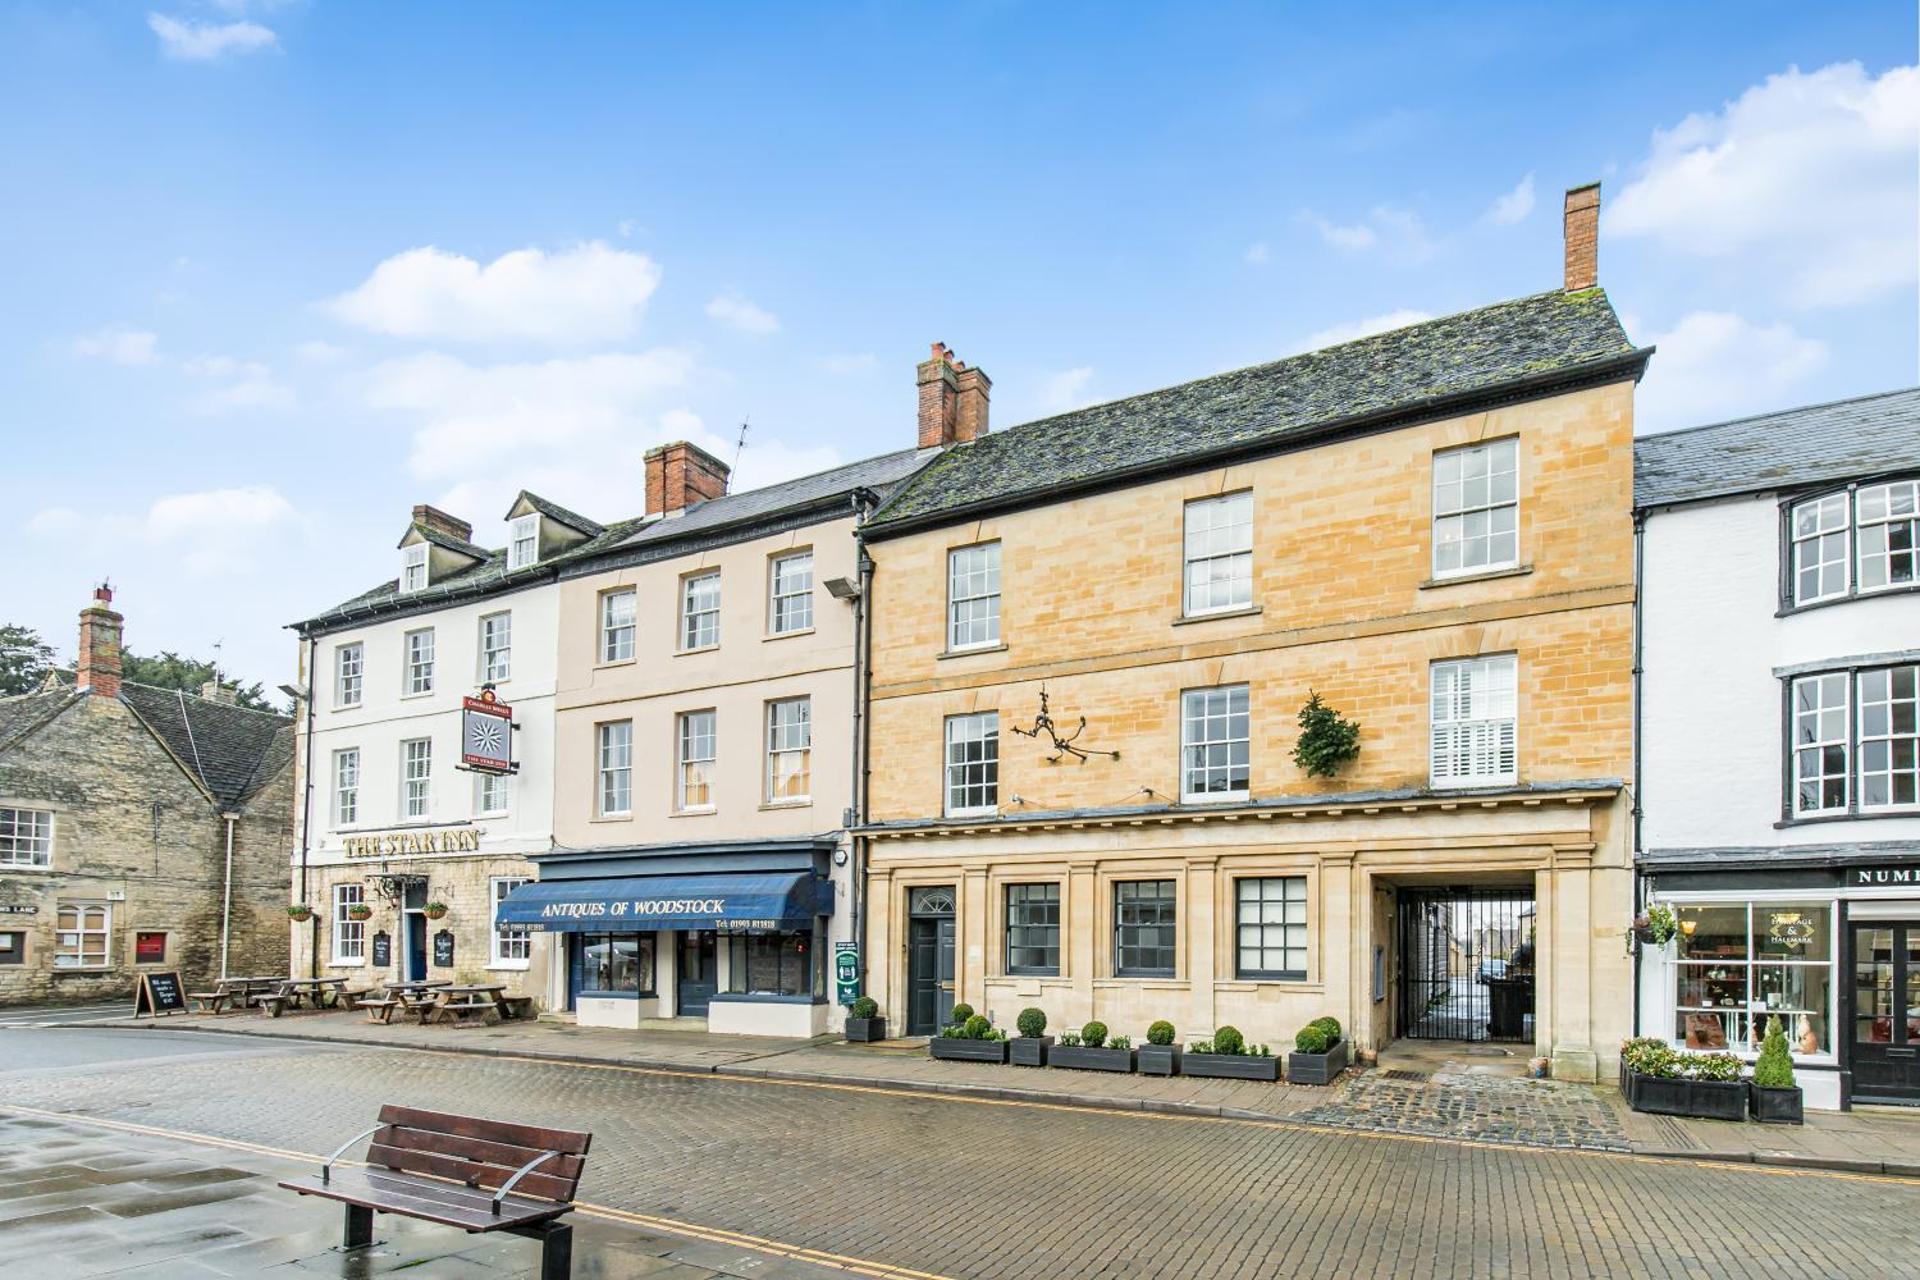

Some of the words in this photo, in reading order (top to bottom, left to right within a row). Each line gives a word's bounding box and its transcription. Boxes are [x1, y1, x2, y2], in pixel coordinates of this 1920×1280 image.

[342, 836, 381, 858] THE
[384, 832, 436, 856] STAR
[442, 829, 480, 851] INN
[541, 902, 606, 919] ANTIQUES
[610, 901, 629, 916] OF
[634, 899, 725, 915] WOODSTOCK
[1787, 926, 1798, 935] &
[1771, 936, 1813, 944] HALLMARK
